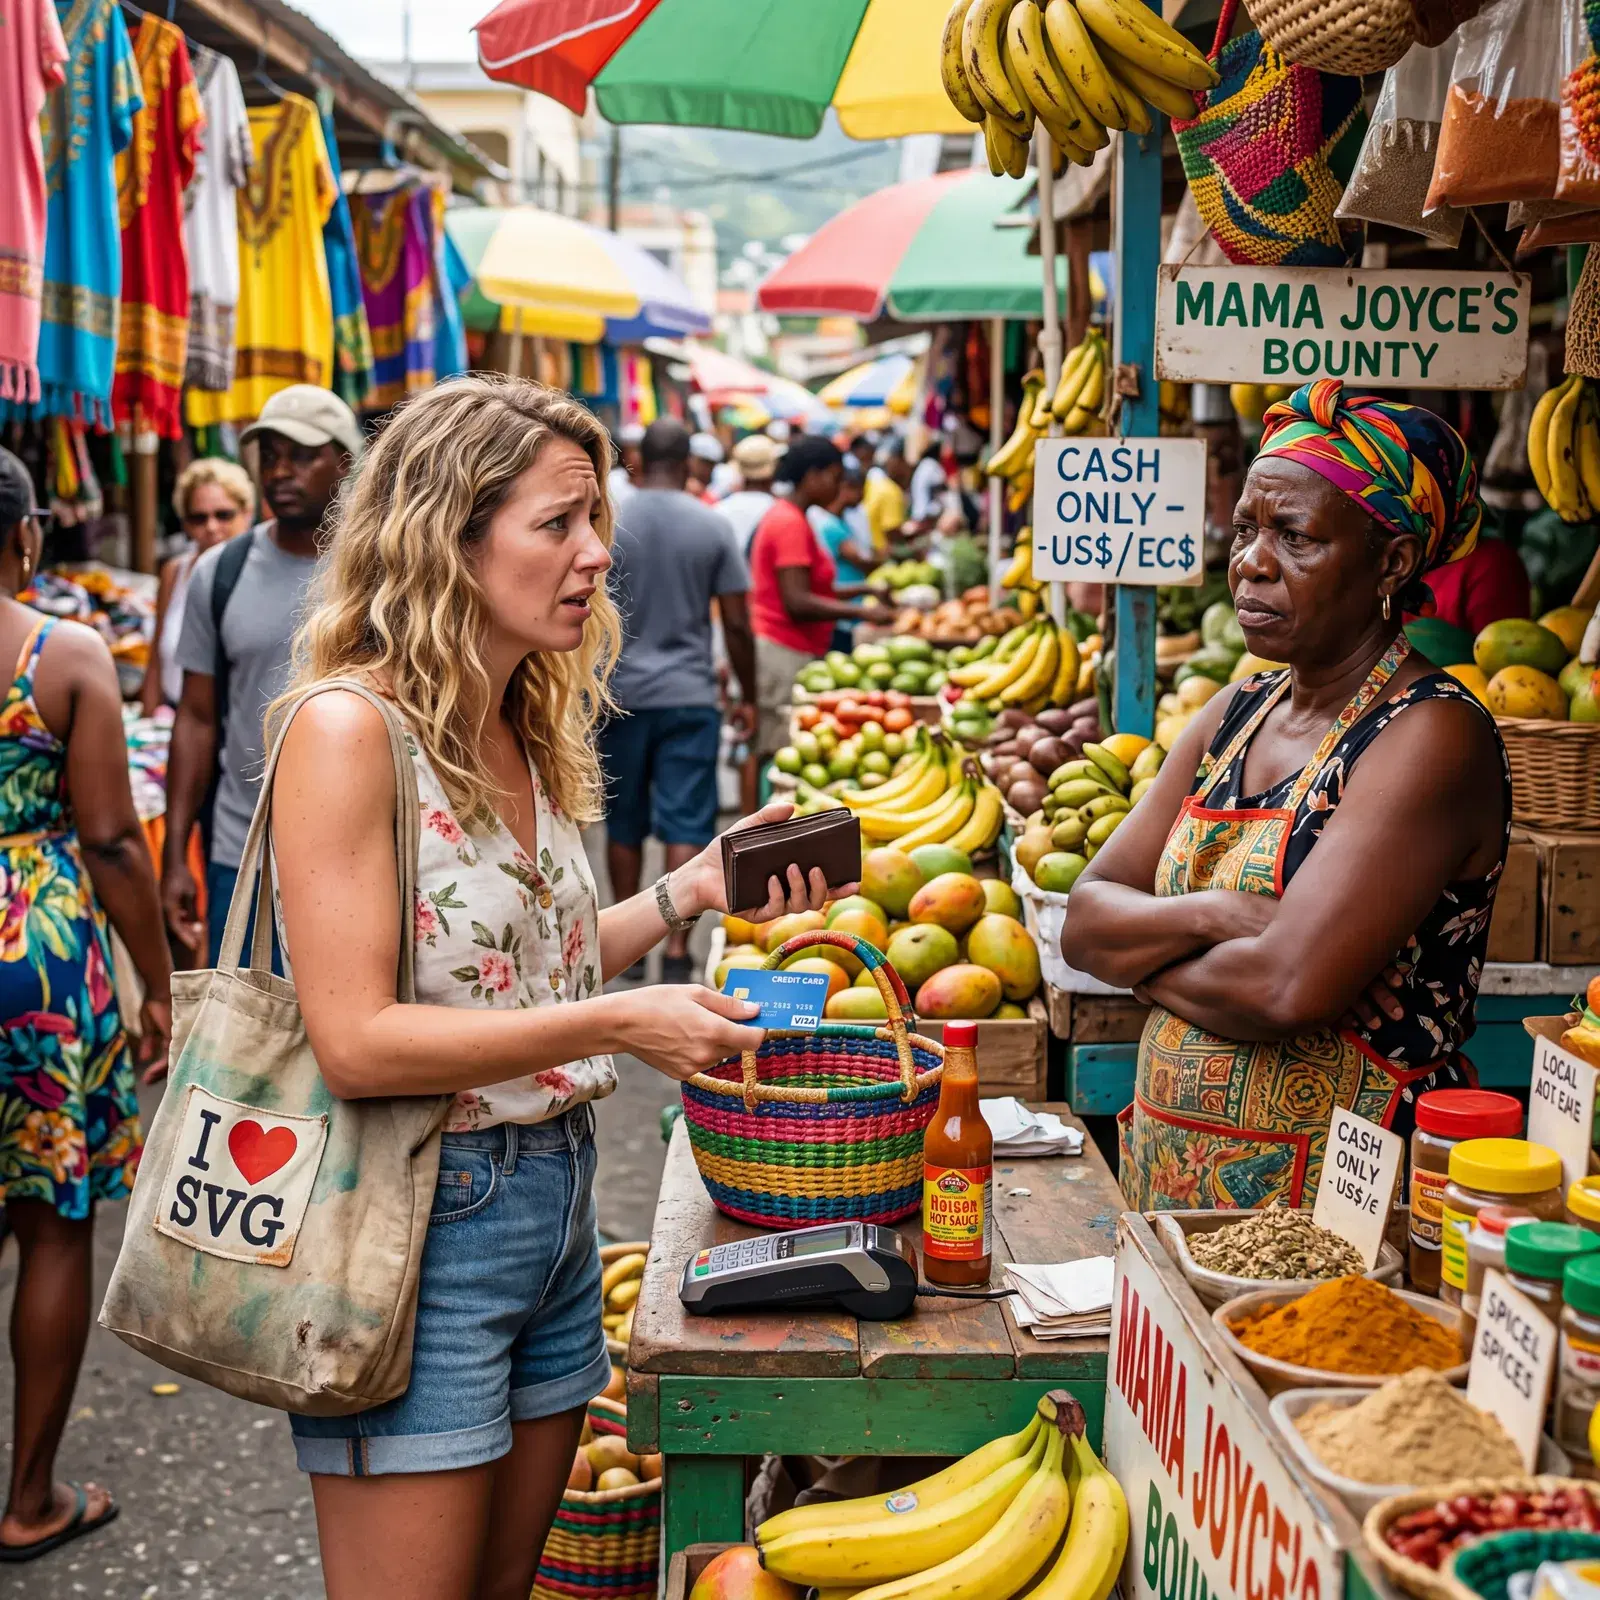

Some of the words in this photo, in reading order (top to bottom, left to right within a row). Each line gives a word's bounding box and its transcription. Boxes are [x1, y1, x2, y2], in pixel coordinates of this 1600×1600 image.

[1176, 281, 1324, 329] MAMA
[1340, 282, 1519, 336] JOYCE'S
[1263, 339, 1439, 379] BOUNTY
[1057, 447, 1160, 483] CASH
[1056, 491, 1156, 525] ONLY
[771, 976, 801, 984] CREDIT
[1542, 1050, 1577, 1090] LOCAL
[188, 1109, 221, 1171] I
[1338, 1121, 1382, 1159] CASH
[1336, 1150, 1380, 1185] ONLY
[169, 1175, 285, 1248] SVG
[929, 1211, 947, 1225] HOT
[949, 1214, 979, 1226] SAUCE
[1116, 1274, 1186, 1499] MAMA
